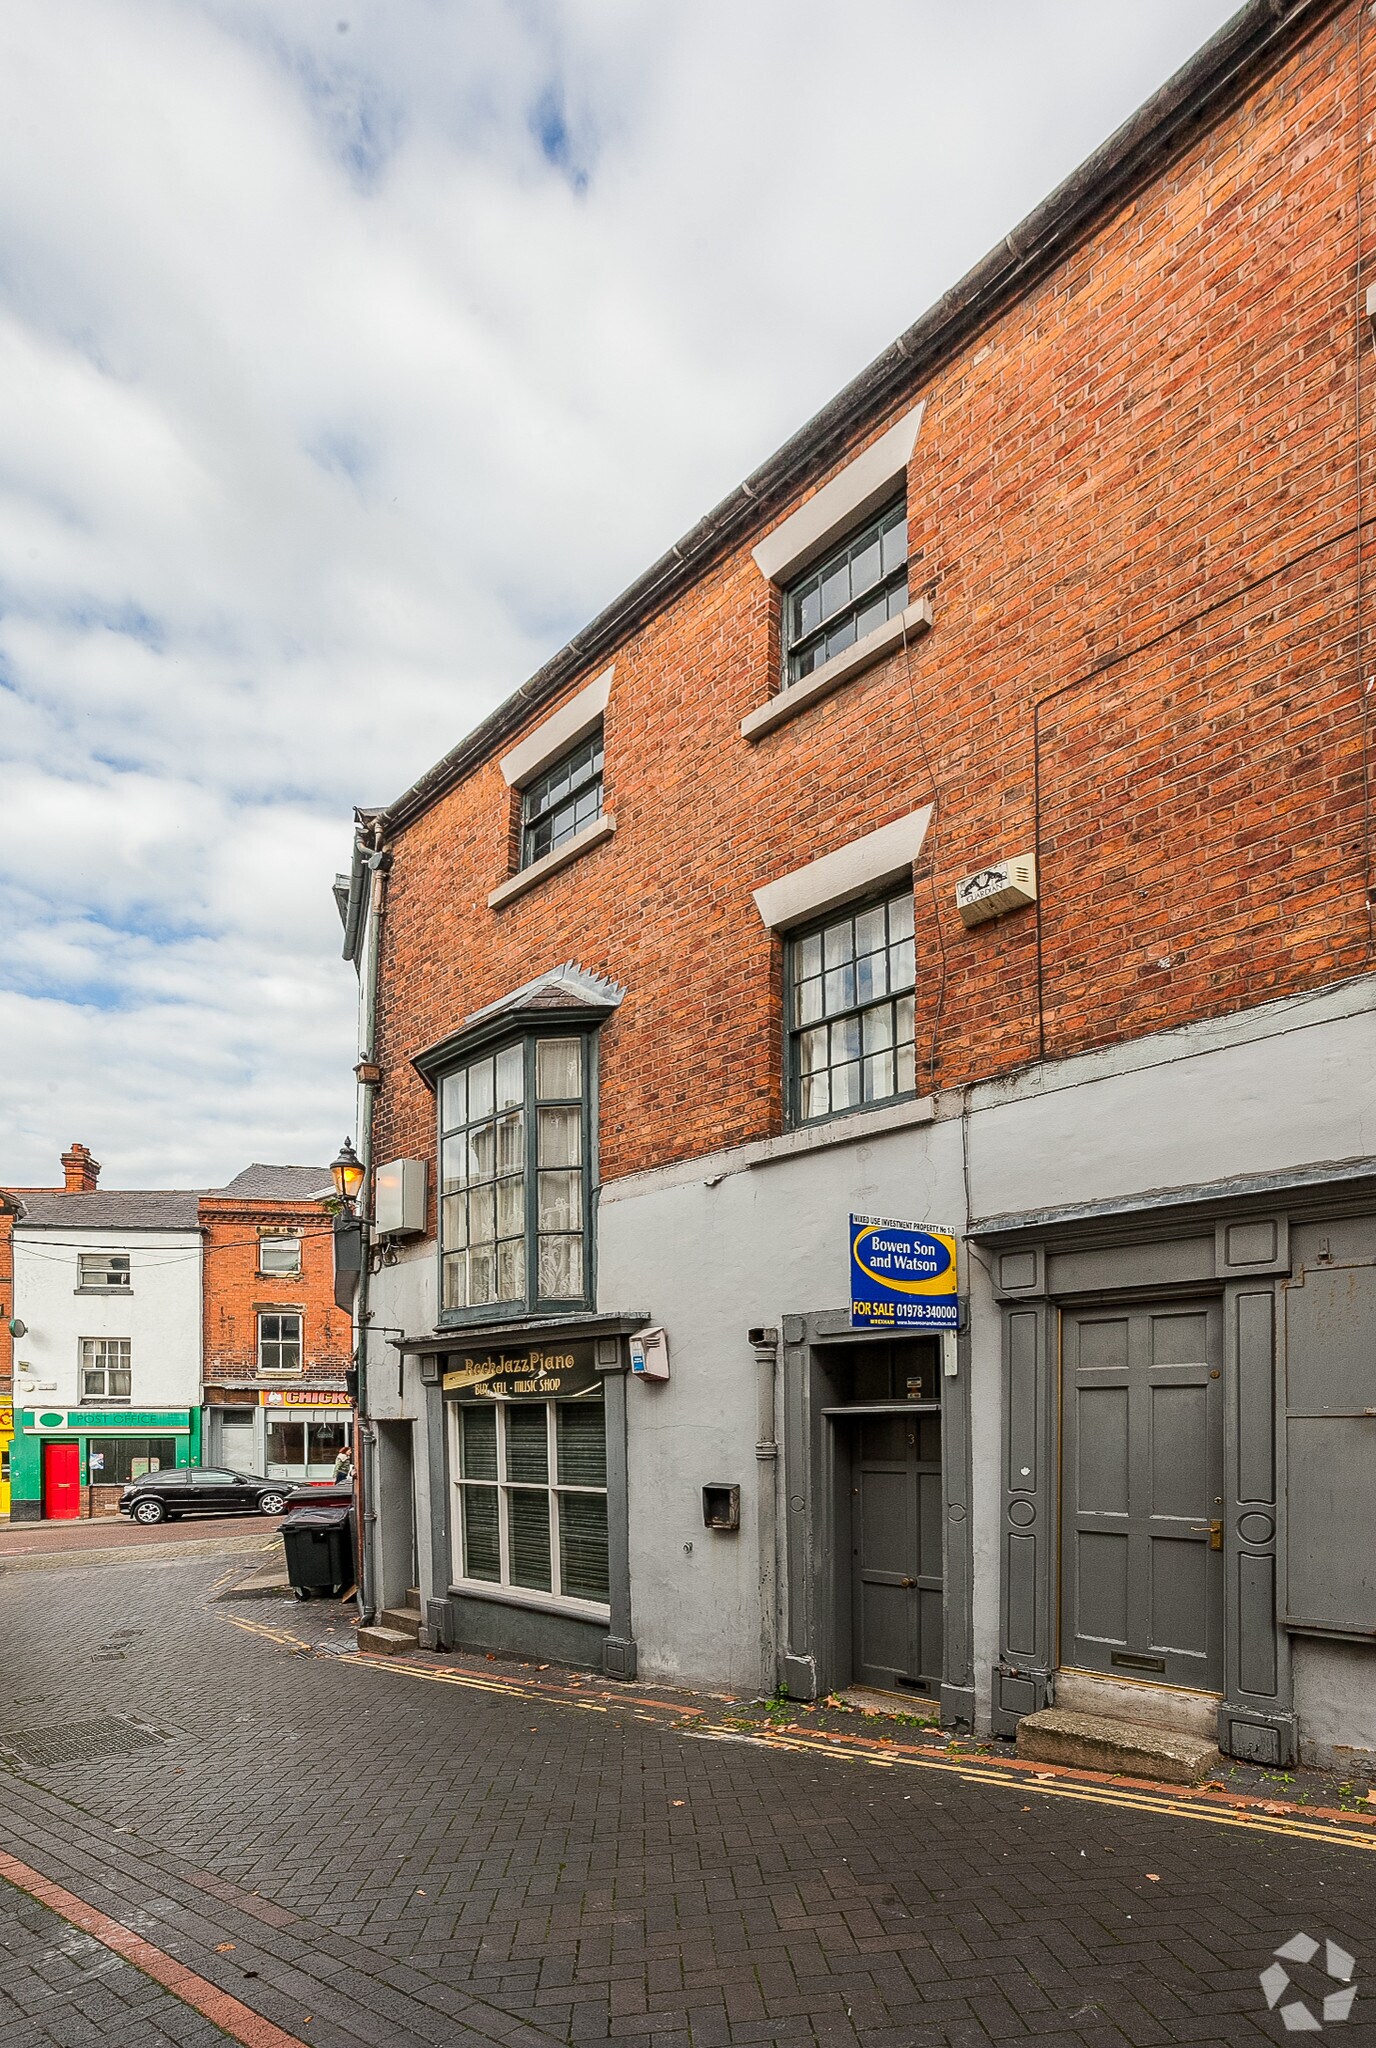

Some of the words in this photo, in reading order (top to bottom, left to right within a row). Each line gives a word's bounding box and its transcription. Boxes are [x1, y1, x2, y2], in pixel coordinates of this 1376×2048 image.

[870, 1217, 880, 1225] USE
[881, 1218, 912, 1229] INVESTMENT
[913, 1222, 939, 1232] PROPERTY
[872, 1236, 911, 1253] Bowen
[914, 1241, 935, 1256] Son
[870, 1254, 891, 1268] and
[894, 1255, 937, 1271] Watson
[853, 1301, 871, 1316] FOR
[872, 1302, 894, 1316] SALE
[896, 1303, 957, 1319] 01978-340000
[492, 1381, 508, 1394] SELL
[514, 1379, 538, 1393] MUSIC
[540, 1378, 561, 1391] SHOP
[286, 1391, 352, 1404] CHICK
[77, 1414, 108, 1424] POST
[113, 1414, 157, 1424] OFFICE
